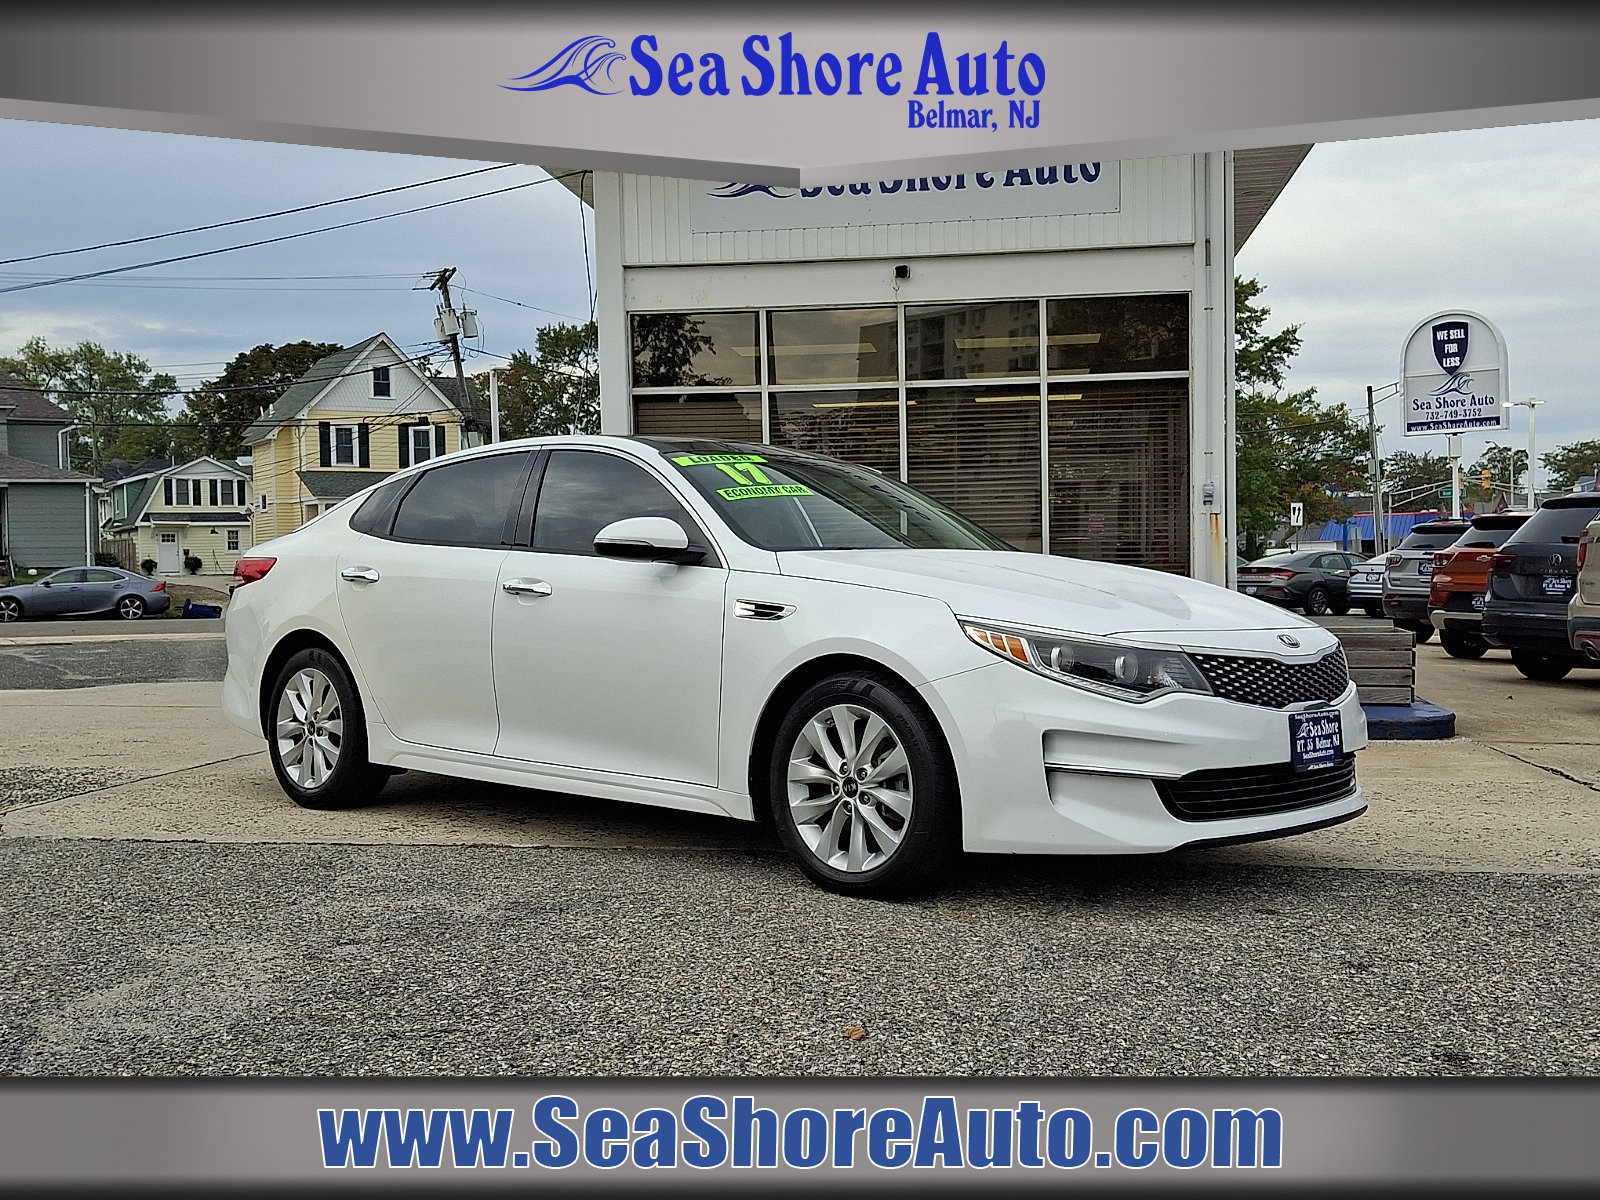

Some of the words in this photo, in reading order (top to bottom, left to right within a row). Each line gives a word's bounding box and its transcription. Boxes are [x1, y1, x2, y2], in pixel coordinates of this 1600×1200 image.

[1436, 330, 1448, 340] WE
[1449, 329, 1465, 339] SELL
[1444, 343, 1458, 353] FOR
[1443, 357, 1460, 367] LESS
[1412, 398, 1432, 411] Sea
[1435, 396, 1466, 409] Shore
[1470, 394, 1495, 407] Auto
[1425, 408, 1482, 420] 732-749-3752
[1410, 419, 1497, 431] www.SeaShoreAuto.com
[715, 463, 773, 485] 17
[723, 487, 781, 498] ECONOMY
[1309, 721, 1321, 736] Sea
[1321, 719, 1338, 735] Shore
[1333, 734, 1340, 746] NJ
